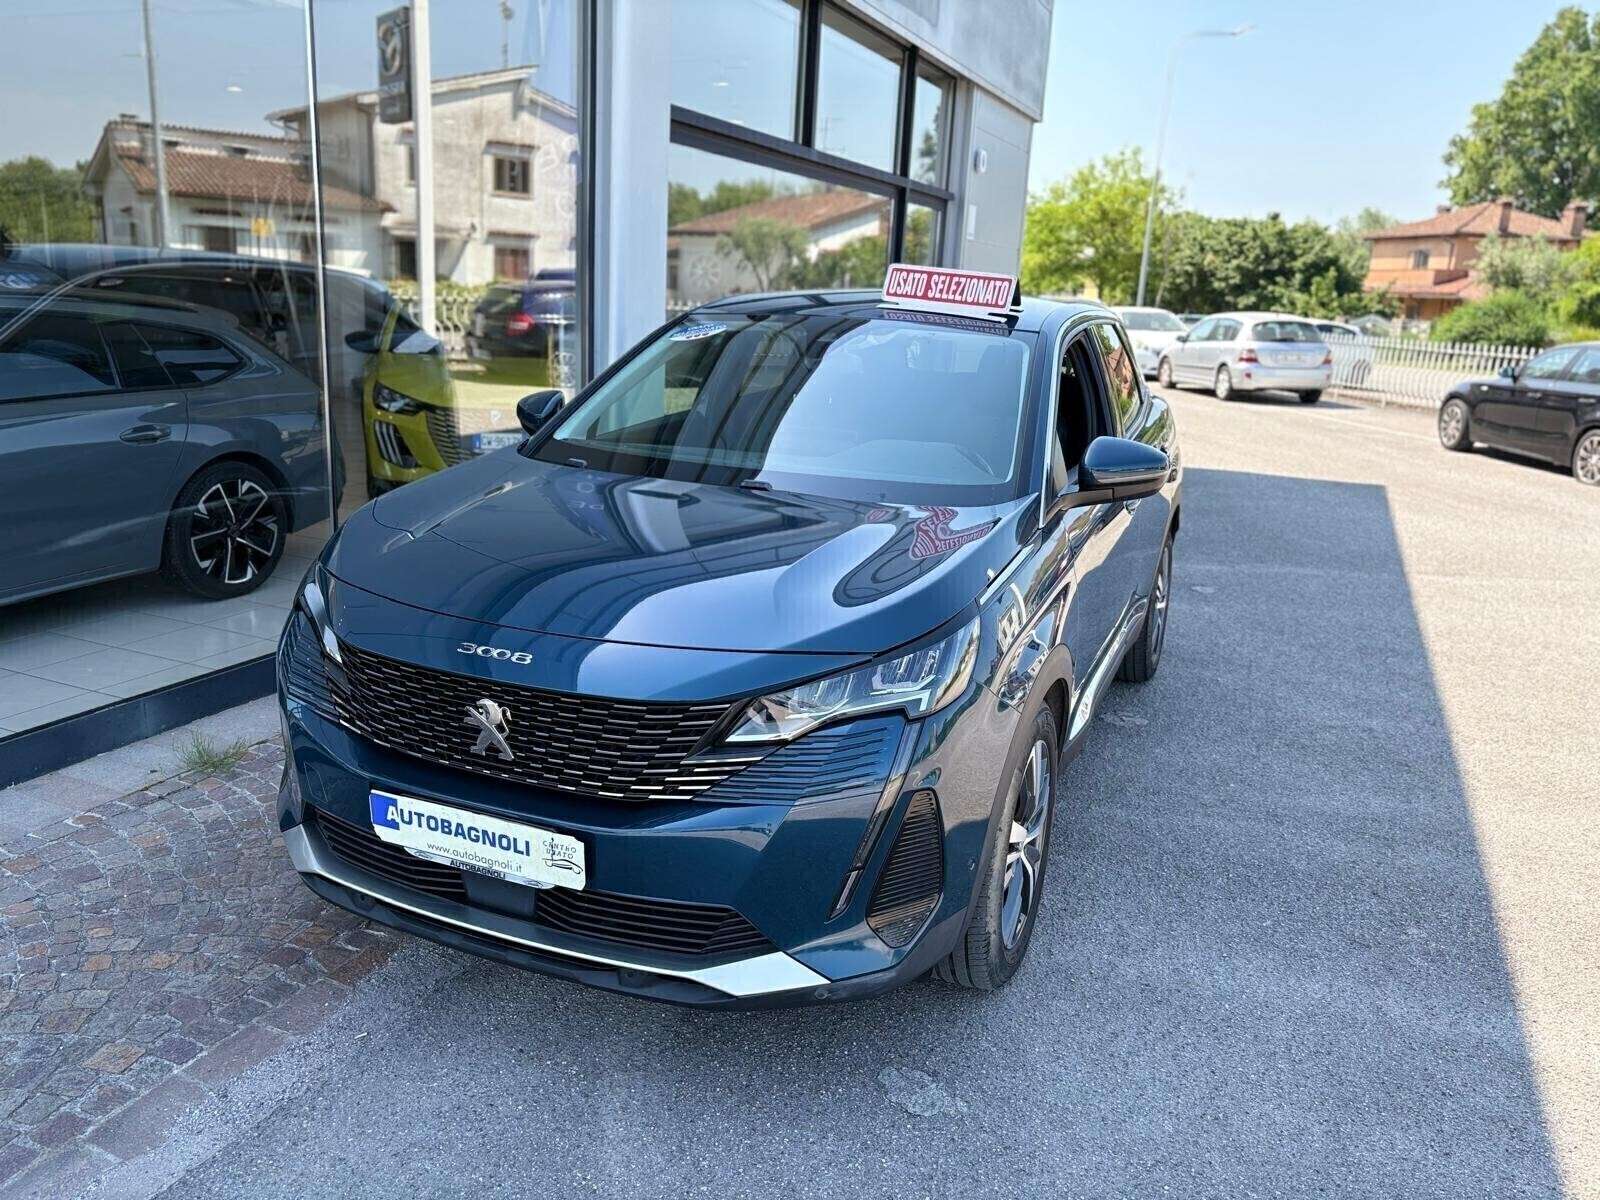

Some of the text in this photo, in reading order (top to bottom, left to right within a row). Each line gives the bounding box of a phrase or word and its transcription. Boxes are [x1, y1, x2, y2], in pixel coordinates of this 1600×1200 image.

[889, 270, 1010, 306] USATO SELEZIONATO
[457, 642, 533, 665] 3008
[386, 805, 531, 857] AUTOBAGNOLI
[427, 842, 522, 873] www.autobagnoli.it
[450, 859, 506, 880] AUTOBAGNOLI
